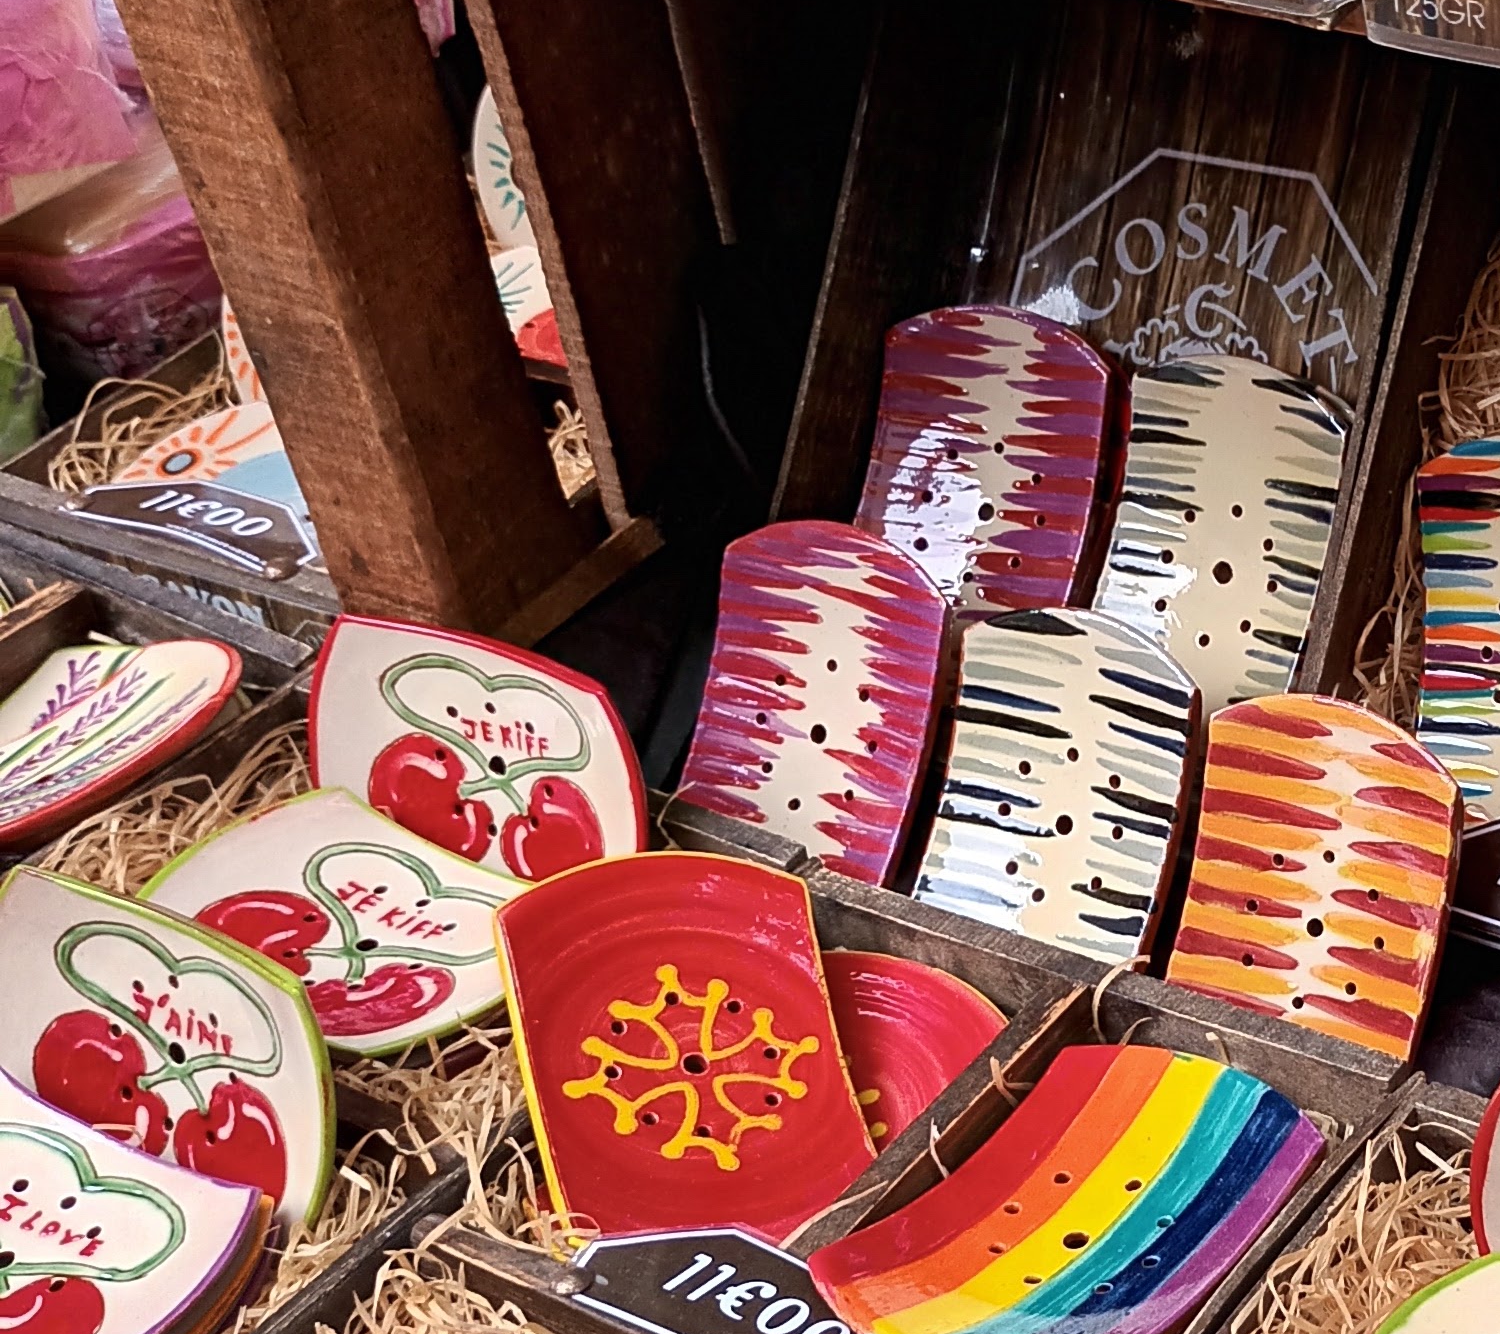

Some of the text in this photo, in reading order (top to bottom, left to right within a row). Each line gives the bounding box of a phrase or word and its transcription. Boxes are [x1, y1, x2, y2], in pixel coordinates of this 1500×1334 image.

[1065, 201, 1360, 368] COSMET
[139, 488, 274, 537] 11€00
[460, 717, 495, 743] JE
[336, 880, 384, 914] JE
